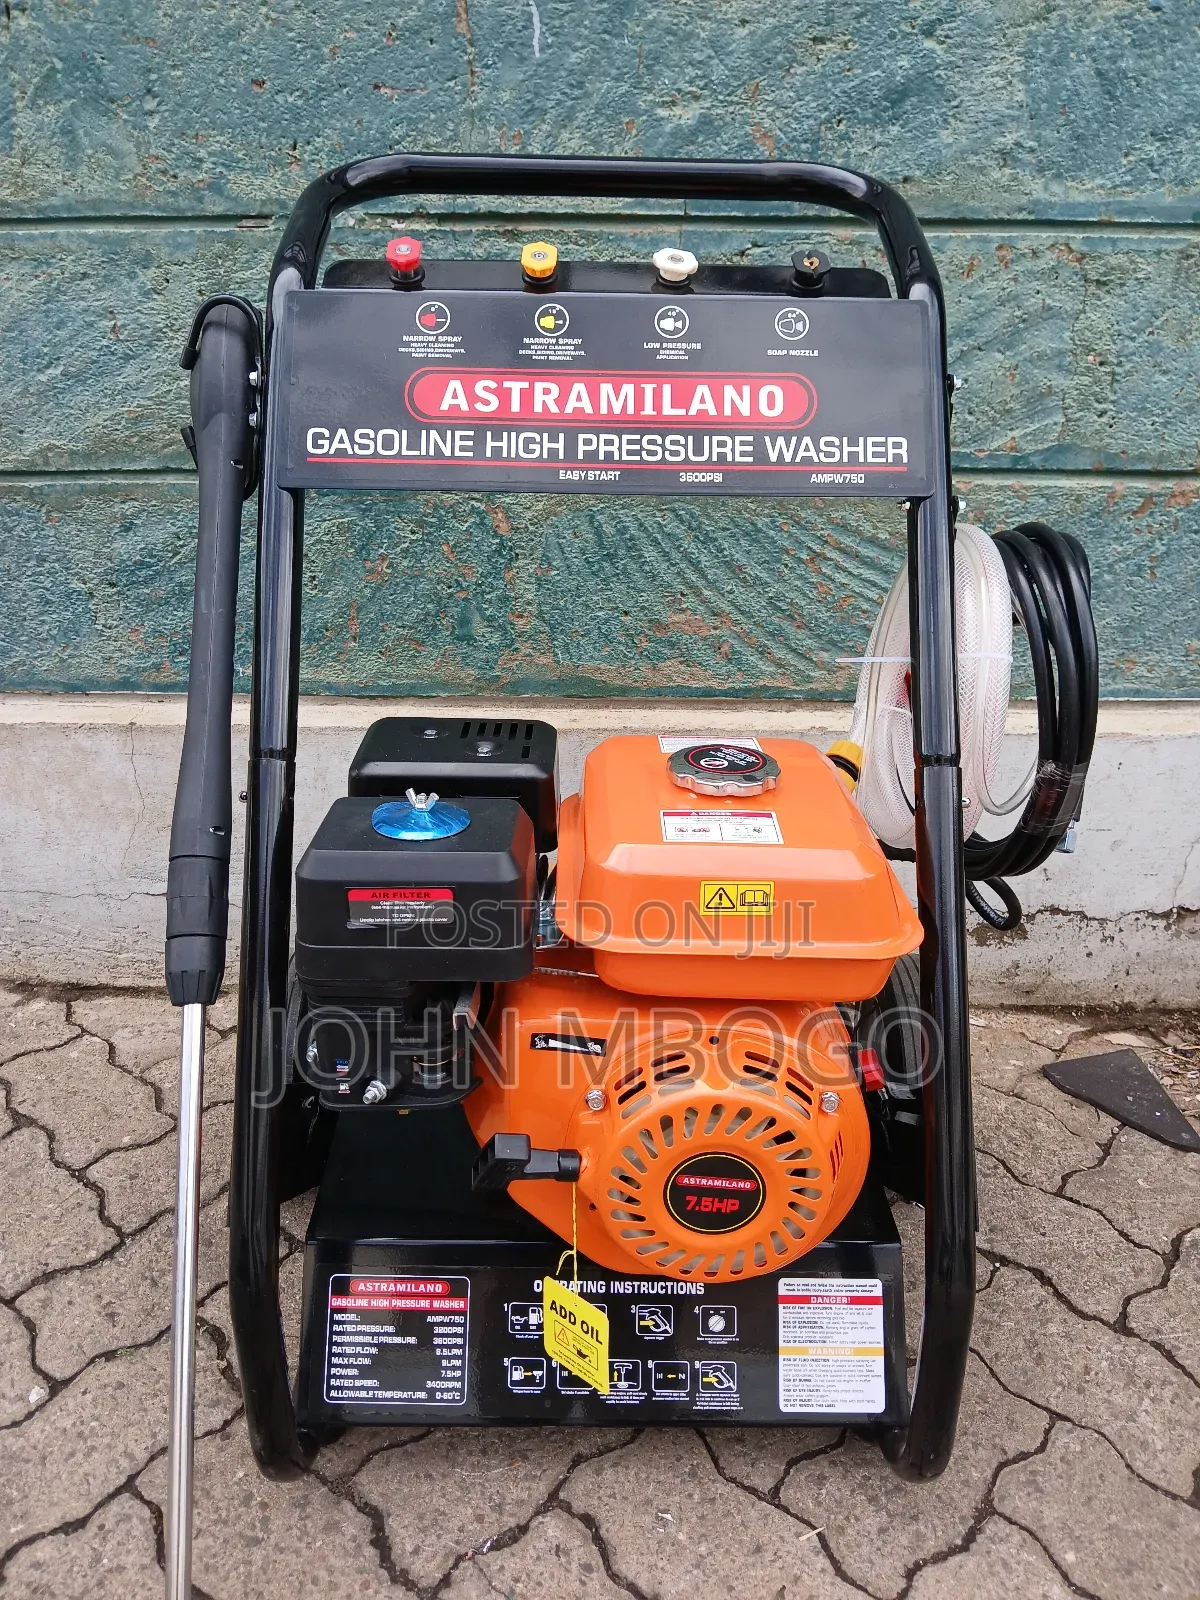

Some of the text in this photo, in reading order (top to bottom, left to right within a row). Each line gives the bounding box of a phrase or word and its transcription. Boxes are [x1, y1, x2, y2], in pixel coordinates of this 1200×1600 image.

[789, 349, 819, 357] NOZZLE
[439, 379, 784, 417] ASTRAMILANO
[306, 427, 908, 464] GASOLINE HIGH PRESSURE WASHER
[558, 469, 621, 481] EASY START
[809, 473, 865, 485] AMPW750
[683, 1177, 751, 1189] ASTRAMILANO
[685, 1195, 740, 1214] 7.5HP
[358, 1282, 443, 1293] ASTRAMILANO
[610, 1281, 705, 1295] INSTRUCTIONS
[331, 1298, 465, 1309] GASOLINE HIGH PRESSURE WASHER
[810, 1296, 851, 1304] DANGER!
[503, 1302, 508, 1312] 1
[630, 1304, 636, 1314] 3
[693, 1305, 700, 1315] 4
[333, 1314, 361, 1322] MODEL:
[426, 1315, 465, 1324] AMPW750
[549, 1299, 577, 1326] ADD
[580, 1320, 603, 1345] OIL
[333, 1325, 396, 1334] RATED PRESSURE:
[332, 1335, 418, 1345] PERMISSIBLE PRESSURE:
[332, 1346, 379, 1356] RATED FLOW:
[808, 1348, 855, 1356] WARNING!
[331, 1357, 372, 1367] MAX FLOW:
[503, 1357, 509, 1367] 5
[330, 1368, 360, 1377] POWER:
[440, 1370, 462, 1379] 7.5HP
[330, 1379, 380, 1389] RATED SPEED:
[425, 1381, 462, 1390] 3400RPM
[329, 1390, 428, 1400] ALLOWABLE TEMPERATURE:
